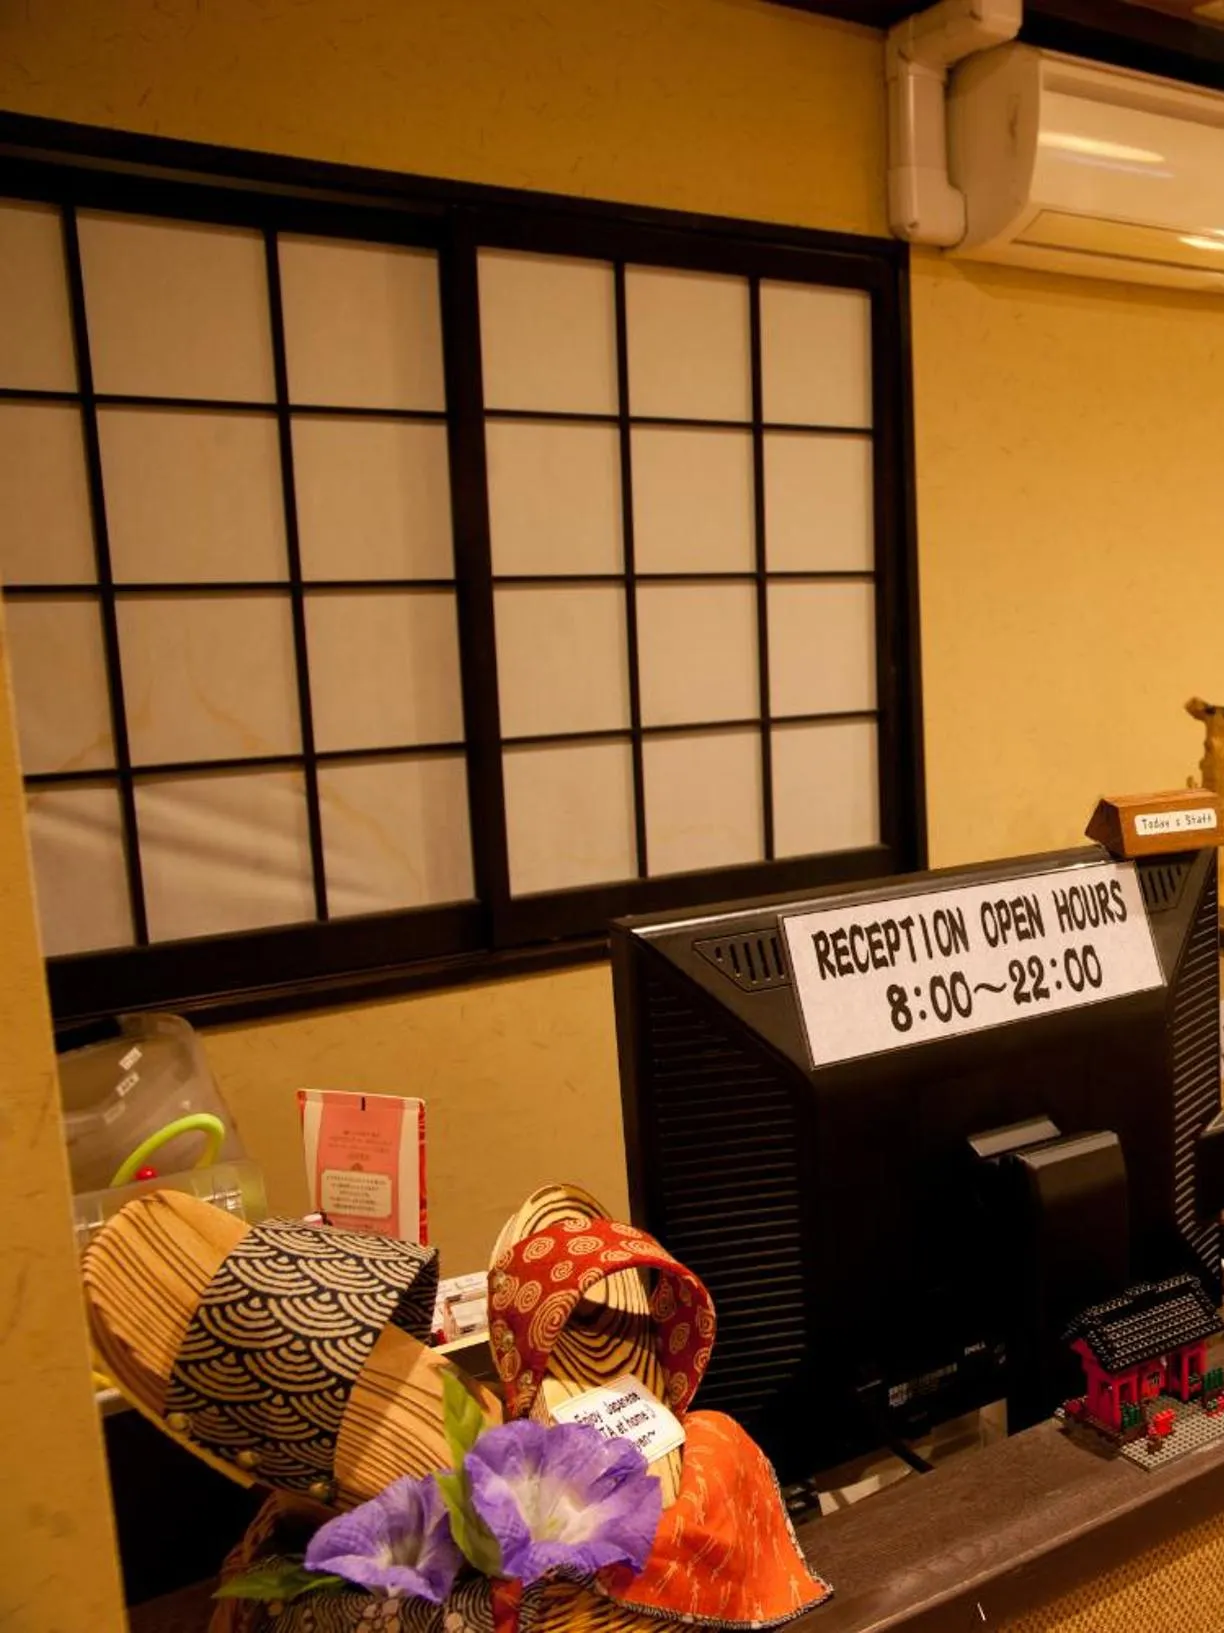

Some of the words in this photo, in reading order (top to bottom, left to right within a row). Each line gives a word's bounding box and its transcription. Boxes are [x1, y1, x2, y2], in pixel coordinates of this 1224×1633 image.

[811, 906, 970, 980] RECEPTION
[980, 893, 1046, 948] OPEN
[1051, 879, 1127, 933] HOURS
